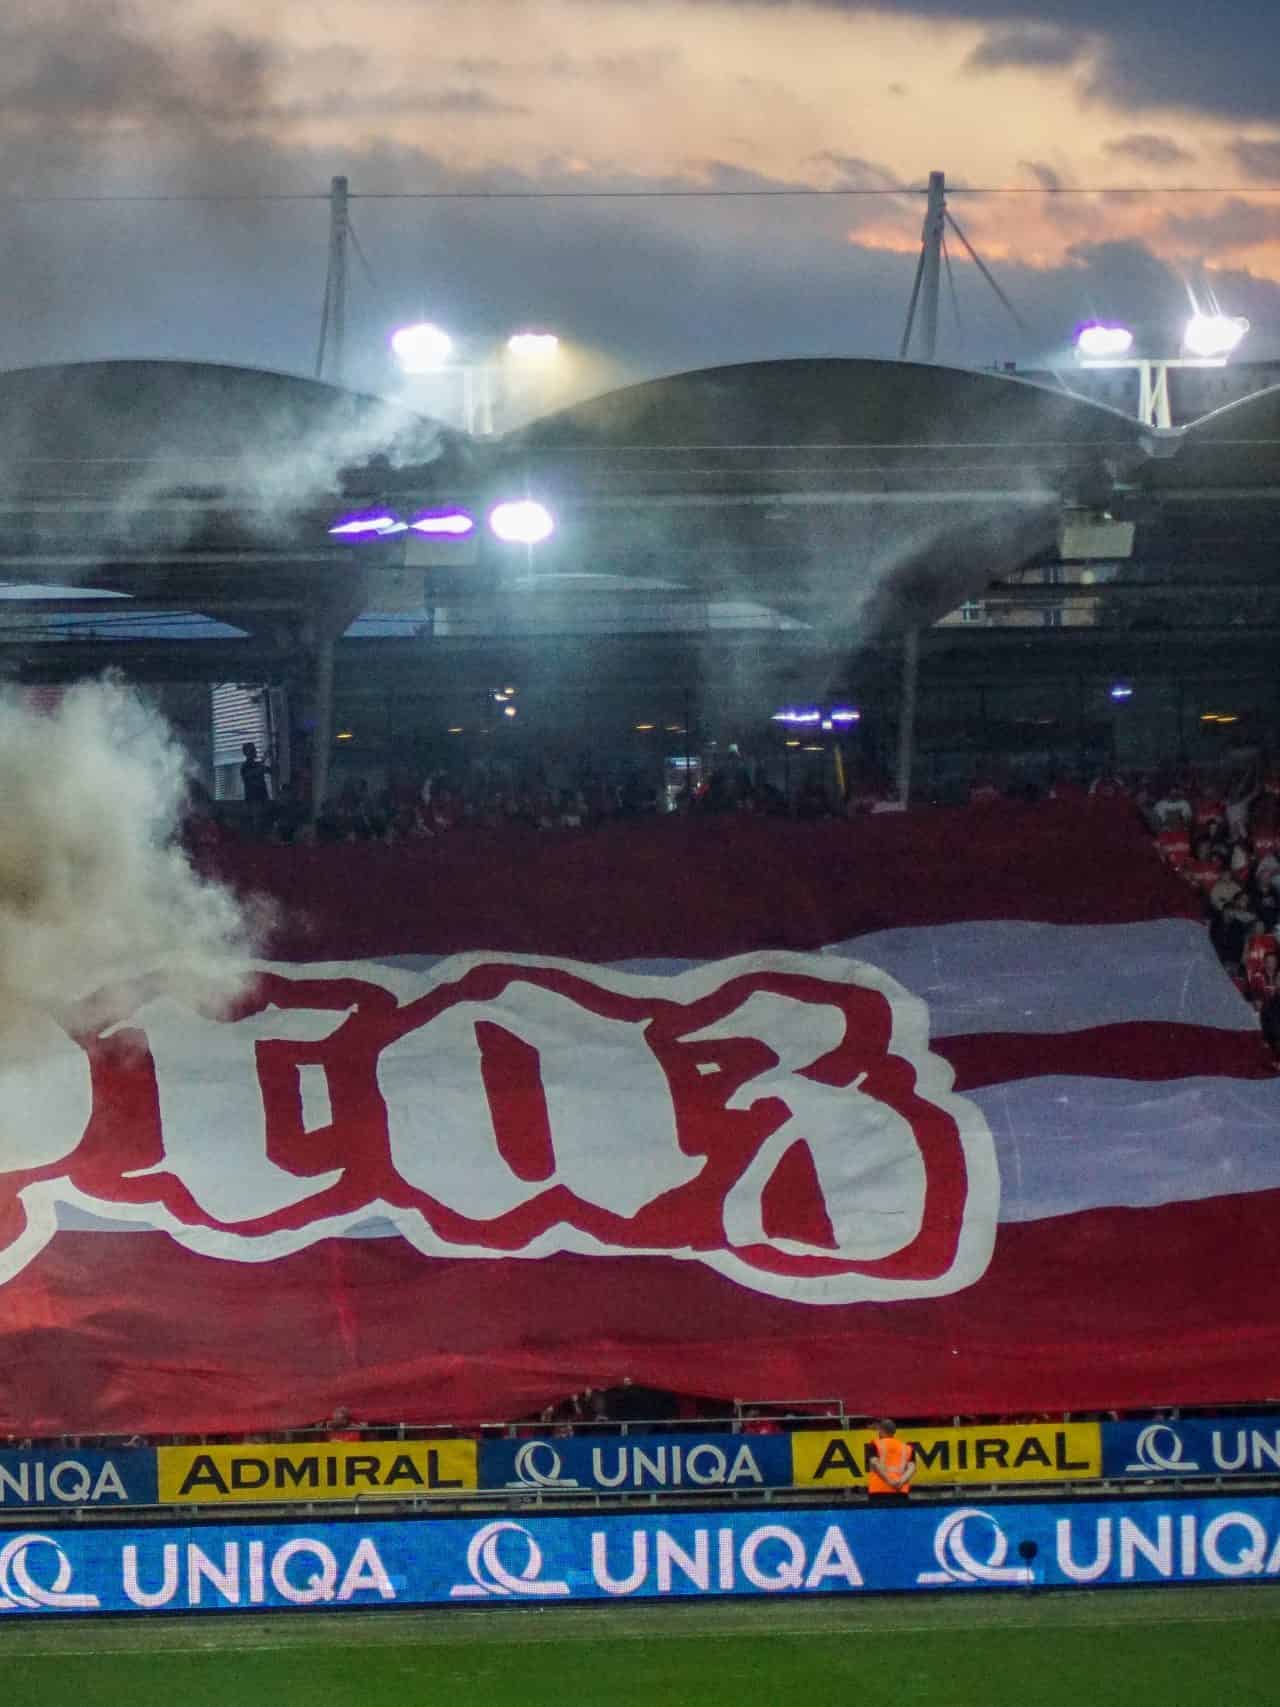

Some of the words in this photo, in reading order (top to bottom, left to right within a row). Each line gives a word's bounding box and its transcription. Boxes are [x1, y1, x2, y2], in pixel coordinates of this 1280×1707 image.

[178, 1450, 463, 1495] ADMIRAL
[592, 1443, 764, 1487] UNIQA
[813, 1432, 1090, 1479] AMIRAL
[122, 1537, 395, 1607] UNIQA
[591, 1525, 864, 1596] UNIQA
[1056, 1511, 1280, 1581] UNIQ
